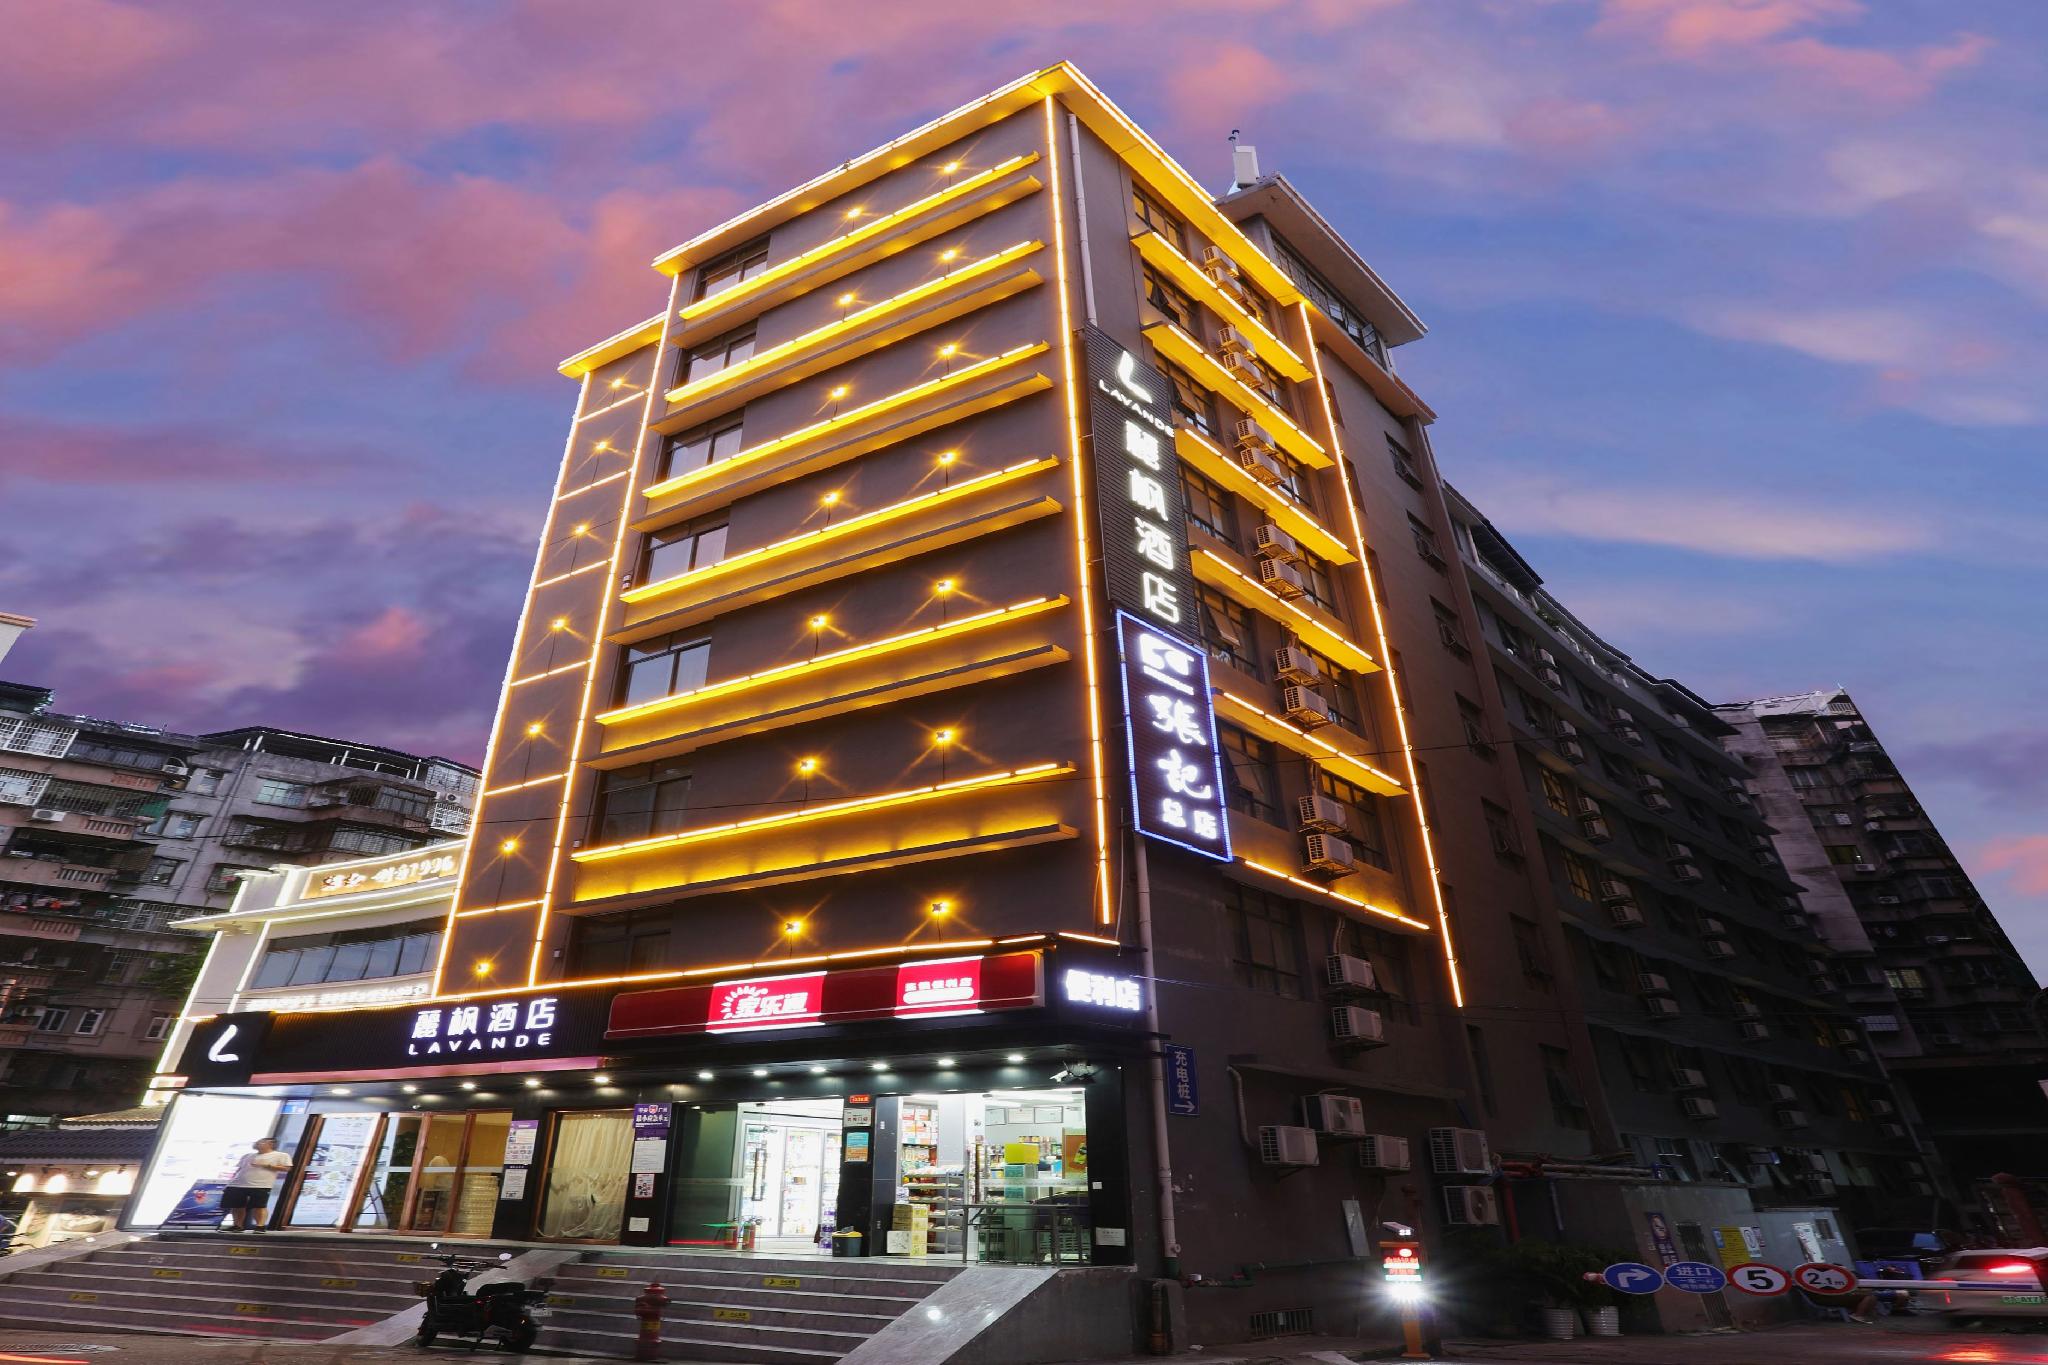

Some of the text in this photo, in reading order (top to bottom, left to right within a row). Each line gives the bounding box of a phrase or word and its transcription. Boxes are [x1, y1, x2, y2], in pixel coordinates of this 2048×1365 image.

[1098, 379, 1175, 437] LAVANDE
[1066, 969, 1140, 1011] 便利店
[408, 1033, 552, 1055] LAVANDE
[1174, 1051, 1191, 1100] 充电桩
[1676, 1266, 1712, 1276] 进口
[1747, 1270, 1774, 1290] 5
[1807, 1272, 1845, 1286] 2.1m
